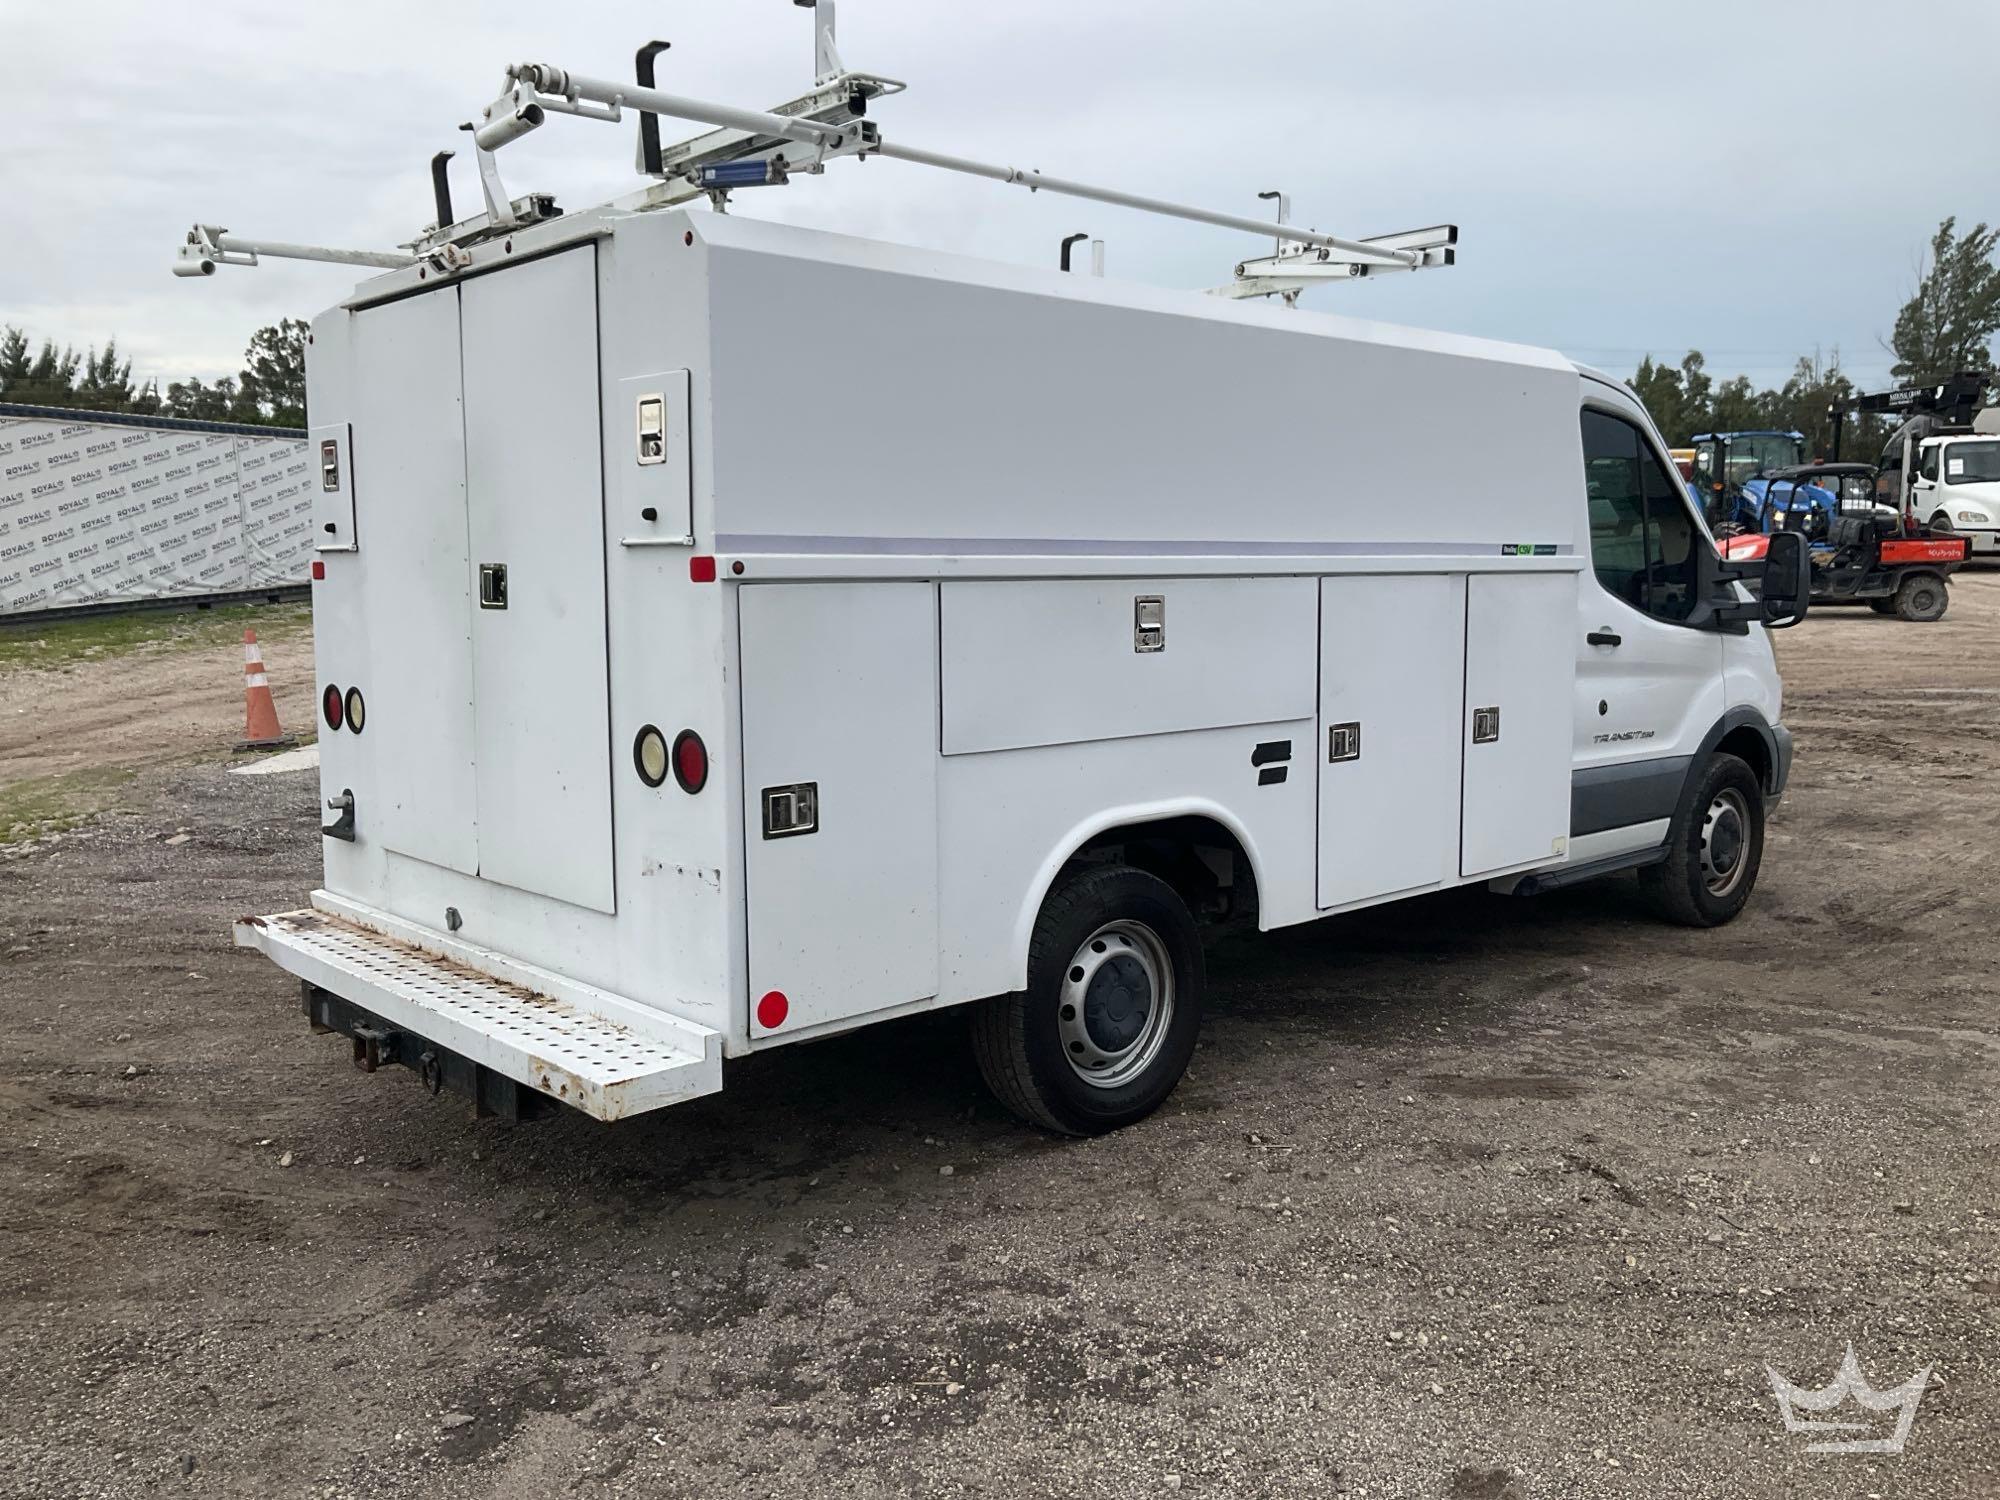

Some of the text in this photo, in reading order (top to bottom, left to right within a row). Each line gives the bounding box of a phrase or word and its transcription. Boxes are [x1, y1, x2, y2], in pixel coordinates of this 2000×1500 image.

[20, 434, 47, 445] ROYAL
[122, 434, 144, 444] ROYAL
[86, 442, 110, 453] ROYAL
[176, 442, 196, 452] ROYAL
[47, 453, 73, 464] ROYAL
[143, 452, 165, 462] ROYAL
[108, 461, 131, 472] ROYAL
[196, 458, 215, 468] ROYAL
[5, 464, 33, 475] ROYAL
[165, 468, 185, 478] ROYAL
[71, 471, 96, 482] ROYAL
[31, 482, 58, 494] ROYAL
[131, 477, 153, 488] ROYAL
[96, 488, 119, 500] ROYAL
[184, 484, 203, 494] ROYAL
[151, 495, 173, 505] ROYAL
[58, 500, 83, 512] ROYAL
[117, 505, 139, 517] ROYAL
[17, 513, 44, 525] ROYAL
[173, 510, 194, 520] ROYAL
[81, 516, 105, 529] ROYAL
[140, 521, 162, 533] ROYAL
[41, 530, 68, 543] ROYAL
[192, 526, 212, 536] ROYAL
[105, 533, 128, 545] ROYAL
[160, 537, 182, 548] ROYAL
[0, 544, 28, 557] ROYAL
[68, 546, 90, 559] ROYAL
[127, 549, 148, 561] ROYAL
[1928, 549, 1961, 558] Kubota
[181, 552, 201, 562] ROYAL
[29, 560, 54, 574] ROYAL
[90, 562, 114, 575] ROYAL
[149, 565, 170, 576] ROYAL
[53, 576, 78, 590] ROYAL
[115, 577, 137, 590] ROYAL
[169, 578, 190, 590] ROYAL
[13, 592, 40, 606] ROYAL
[78, 591, 102, 604] ROYAL
[1593, 730, 1642, 744] TRANSIT
